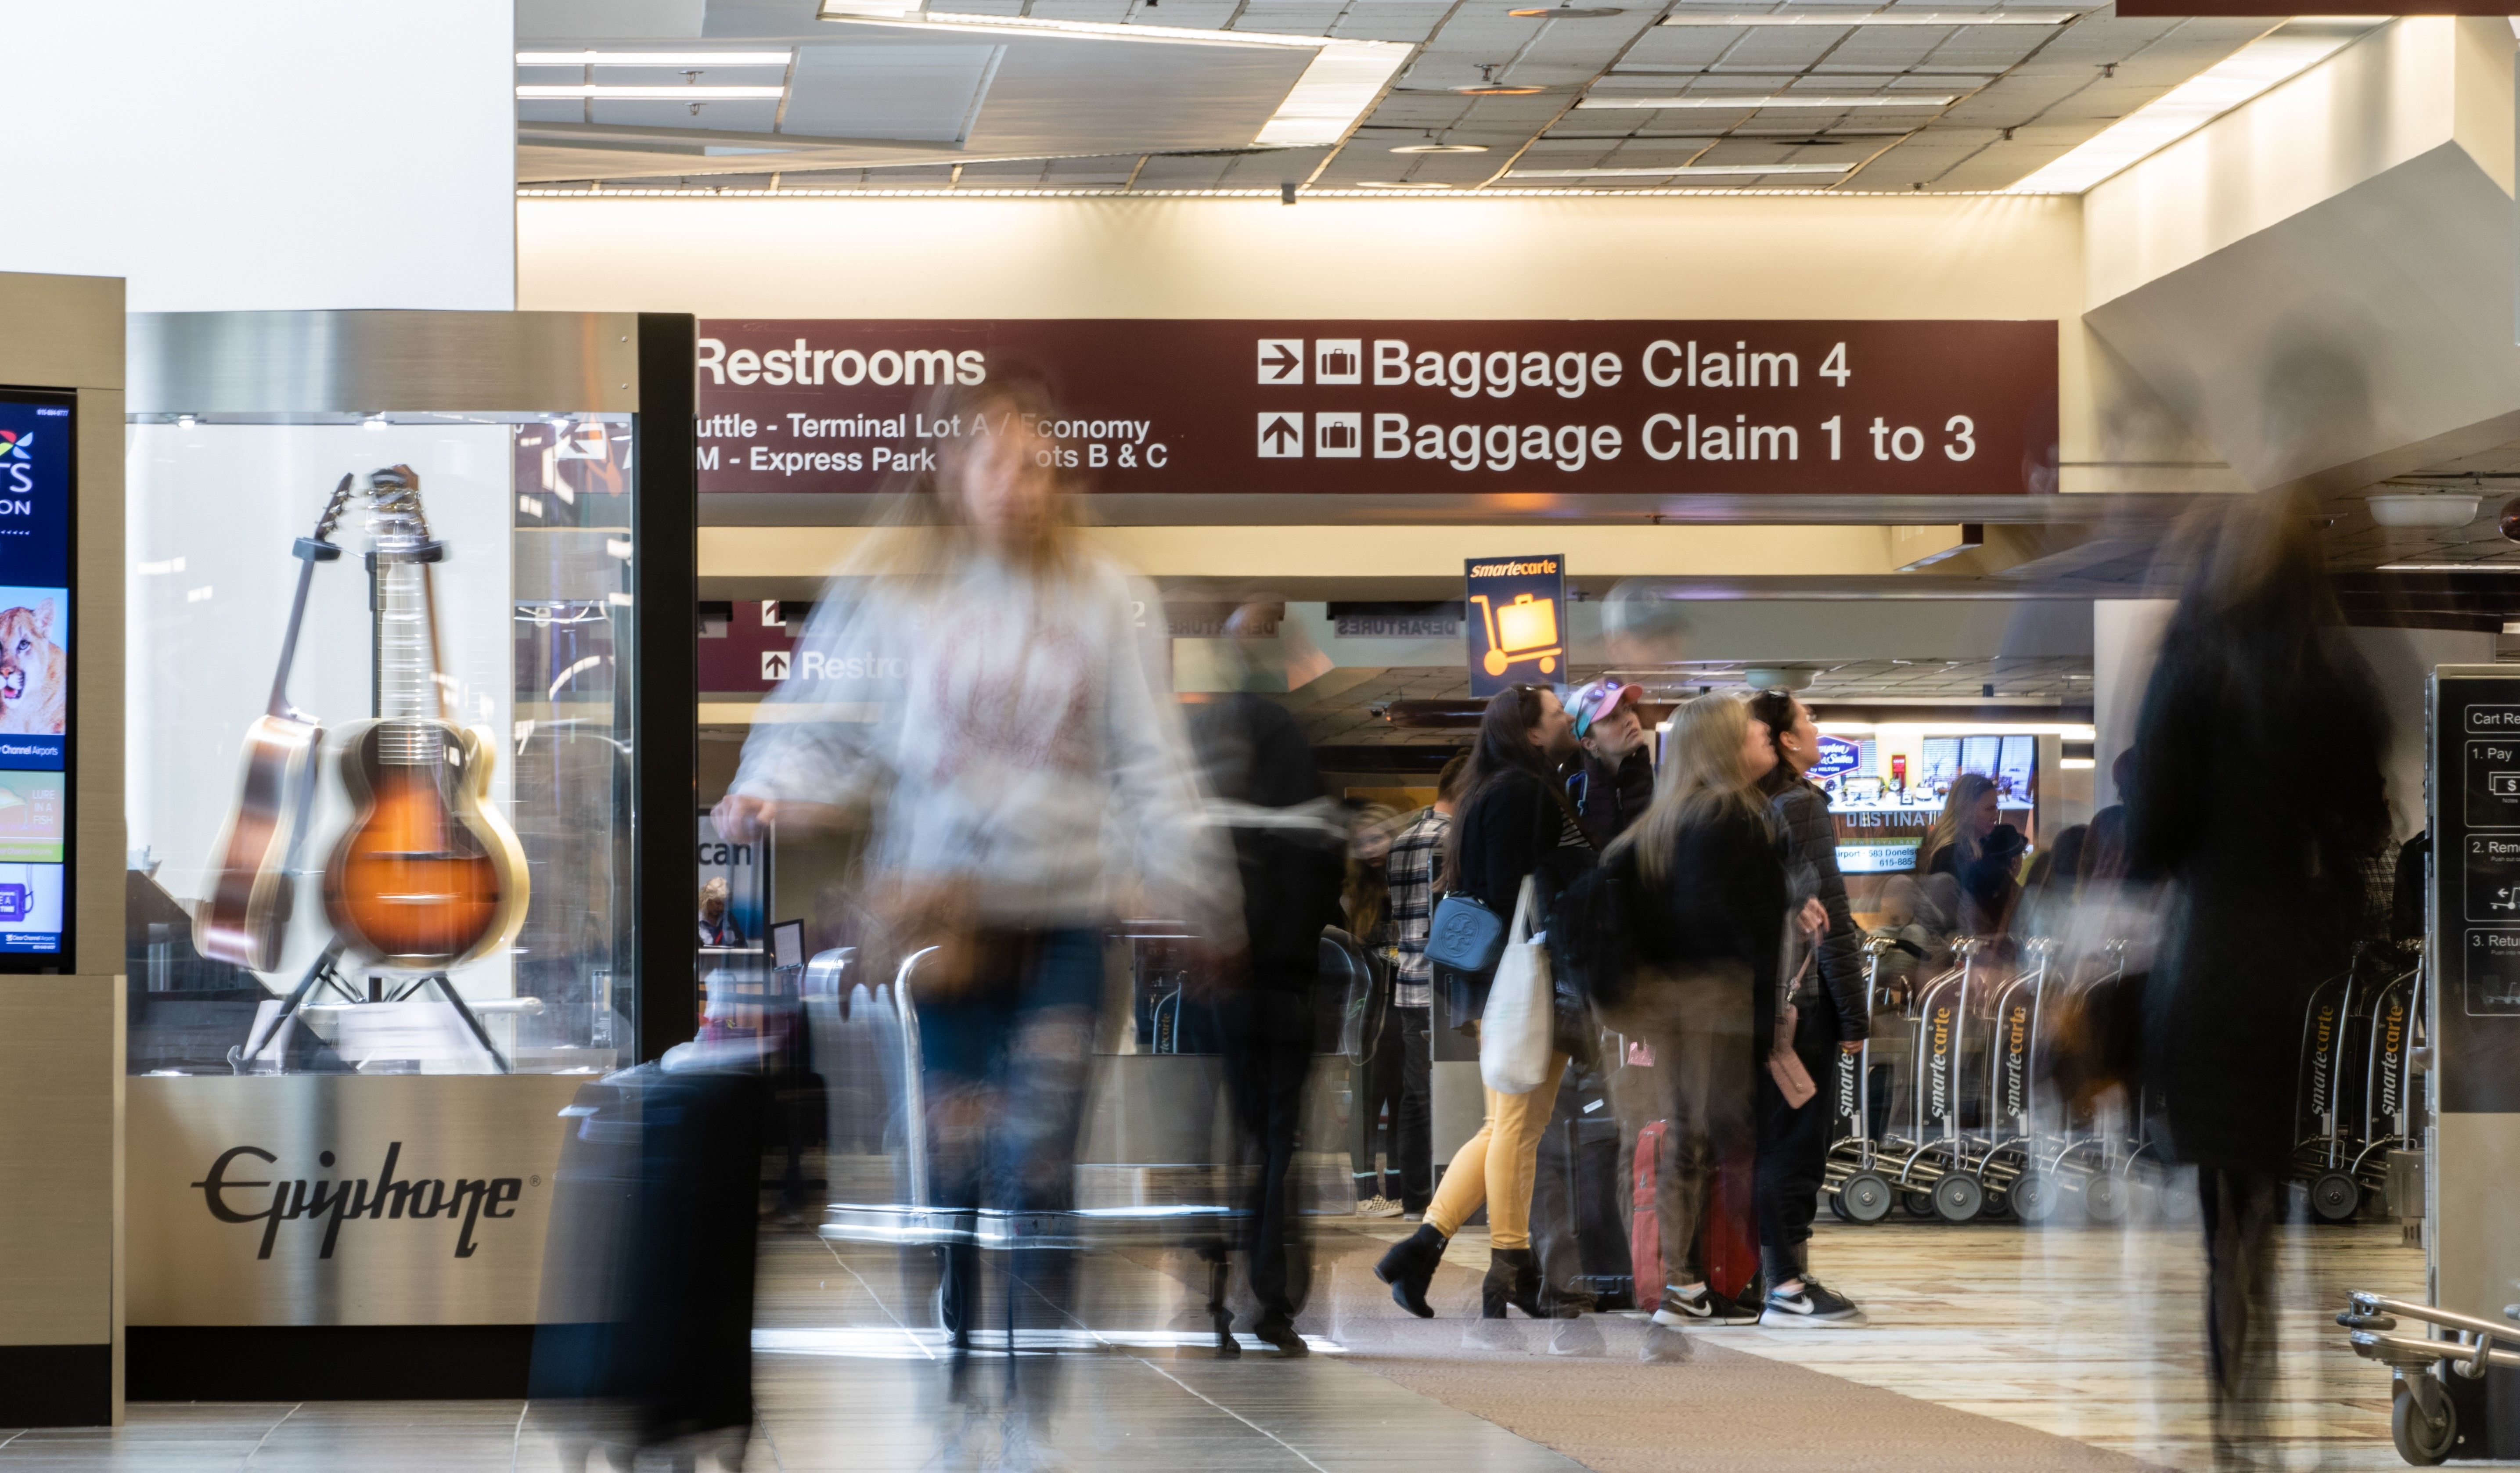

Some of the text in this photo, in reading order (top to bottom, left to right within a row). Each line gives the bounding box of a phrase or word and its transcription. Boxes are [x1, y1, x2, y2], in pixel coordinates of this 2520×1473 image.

[698, 338, 986, 385] Restrooms
[1374, 339, 1851, 398] Baggage Claim 4
[786, 413, 905, 438] Terminal
[916, 414, 961, 438] Lot
[970, 414, 990, 436] A
[998, 413, 1011, 436] /
[1021, 413, 1150, 444] Economy
[1374, 413, 1976, 471] Baggage Claim 1 to 3
[750, 446, 863, 476] Express
[873, 447, 936, 471] Park
[1089, 444, 1109, 467] B
[1118, 444, 1138, 468] &
[1146, 443, 1168, 468] C
[1470, 560, 1557, 578] smartecarte
[2473, 713, 2500, 724] Cart
[2472, 747, 2513, 762] 1. Pay
[1836, 849, 1860, 859] irport
[2472, 841, 2520, 853] 2. Rem
[2472, 935, 2520, 947] 3. Retu
[1837, 1048, 1854, 1117] smarte
[1930, 1007, 1950, 1118] smartecarte
[2005, 1006, 2026, 1117] smartecarte
[2311, 1005, 2333, 1117] smartecarte
[2382, 1005, 2404, 1117] smartecarte
[190, 1142, 522, 1260] Epiphone
